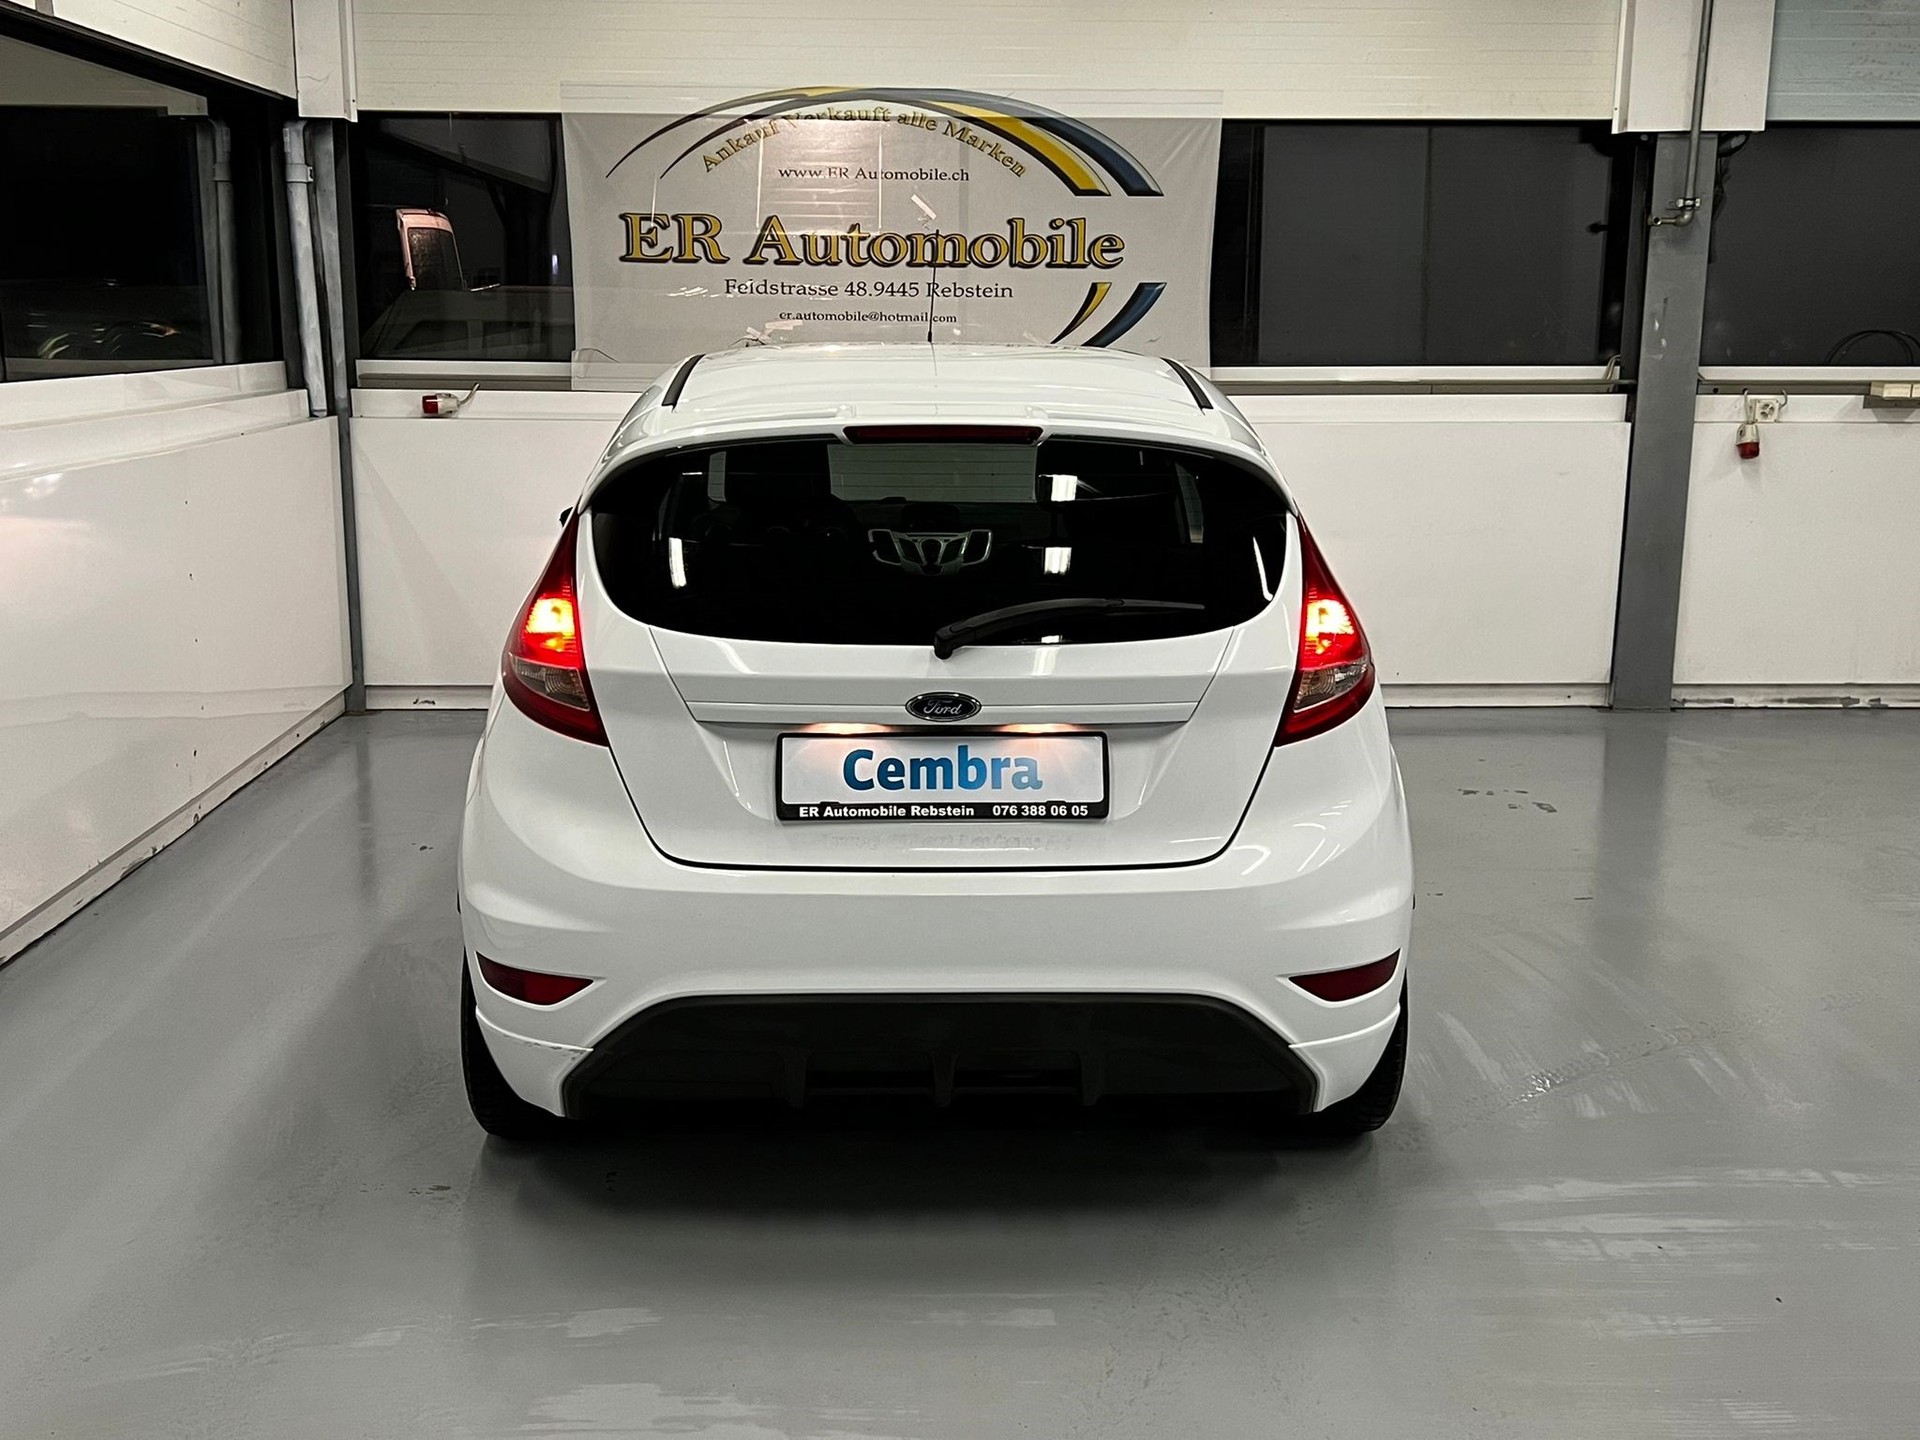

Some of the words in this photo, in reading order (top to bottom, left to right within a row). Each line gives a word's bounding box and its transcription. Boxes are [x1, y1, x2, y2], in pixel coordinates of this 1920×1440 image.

[702, 118, 780, 172] Ankauf
[897, 110, 938, 131] alle
[942, 121, 1027, 178] Marken
[619, 212, 730, 264] ER
[743, 214, 1125, 269] Automobile
[844, 281, 919, 298] 48.9445
[925, 282, 1013, 299] Rebstein
[779, 311, 957, 323] er.automobile@hotmailcom
[923, 700, 962, 714] Ford
[843, 745, 1043, 791] Cembra
[799, 806, 820, 817] ER
[823, 804, 906, 817] Automobile
[910, 804, 975, 816] Rebstein
[992, 804, 1018, 816] 076
[1021, 804, 1046, 816] 388
[1050, 804, 1068, 816] 06
[1071, 804, 1089, 816] 05
